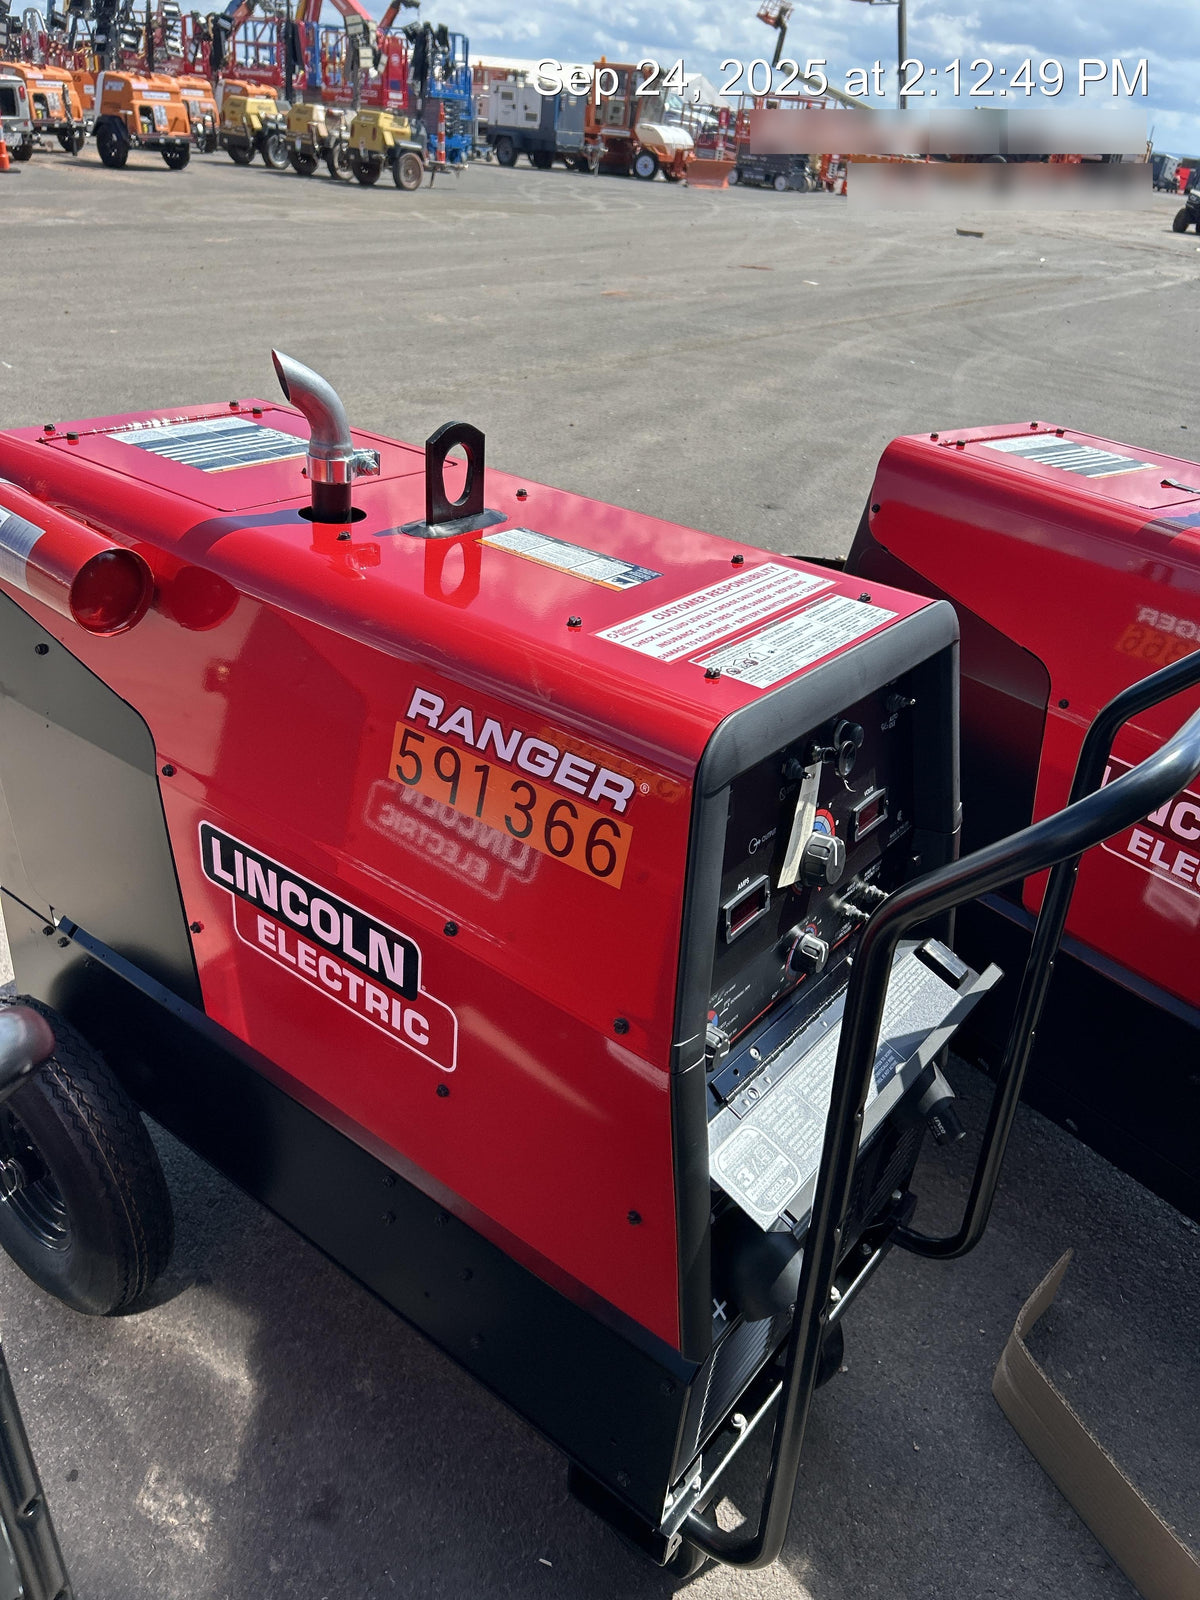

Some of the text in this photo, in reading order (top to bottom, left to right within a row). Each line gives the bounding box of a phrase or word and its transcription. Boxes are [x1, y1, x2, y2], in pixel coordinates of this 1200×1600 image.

[630, 635, 657, 647] CHECK
[652, 629, 671, 637] ALL
[666, 621, 689, 631] FLUID
[684, 611, 713, 623] LEVELS
[713, 599, 740, 611] GREASE
[735, 592, 756, 601] DAILY
[752, 583, 777, 593] BEFORE
[650, 565, 780, 620] CUSTOMER RESPONSIBILITY
[655, 629, 697, 648] INSURANCE
[696, 620, 717, 629] FLAT
[711, 612, 734, 622] TIRES
[746, 594, 775, 606] DAMAGE
[656, 644, 689, 659] DAMAGE
[695, 623, 733, 642] EQUIPMENT
[733, 610, 763, 623] BATTERY
[758, 592, 802, 612] MAINTENANCE
[396, 728, 622, 878] 591366
[211, 837, 404, 988] LINCOLN
[257, 914, 430, 1045] ELECTRIC
